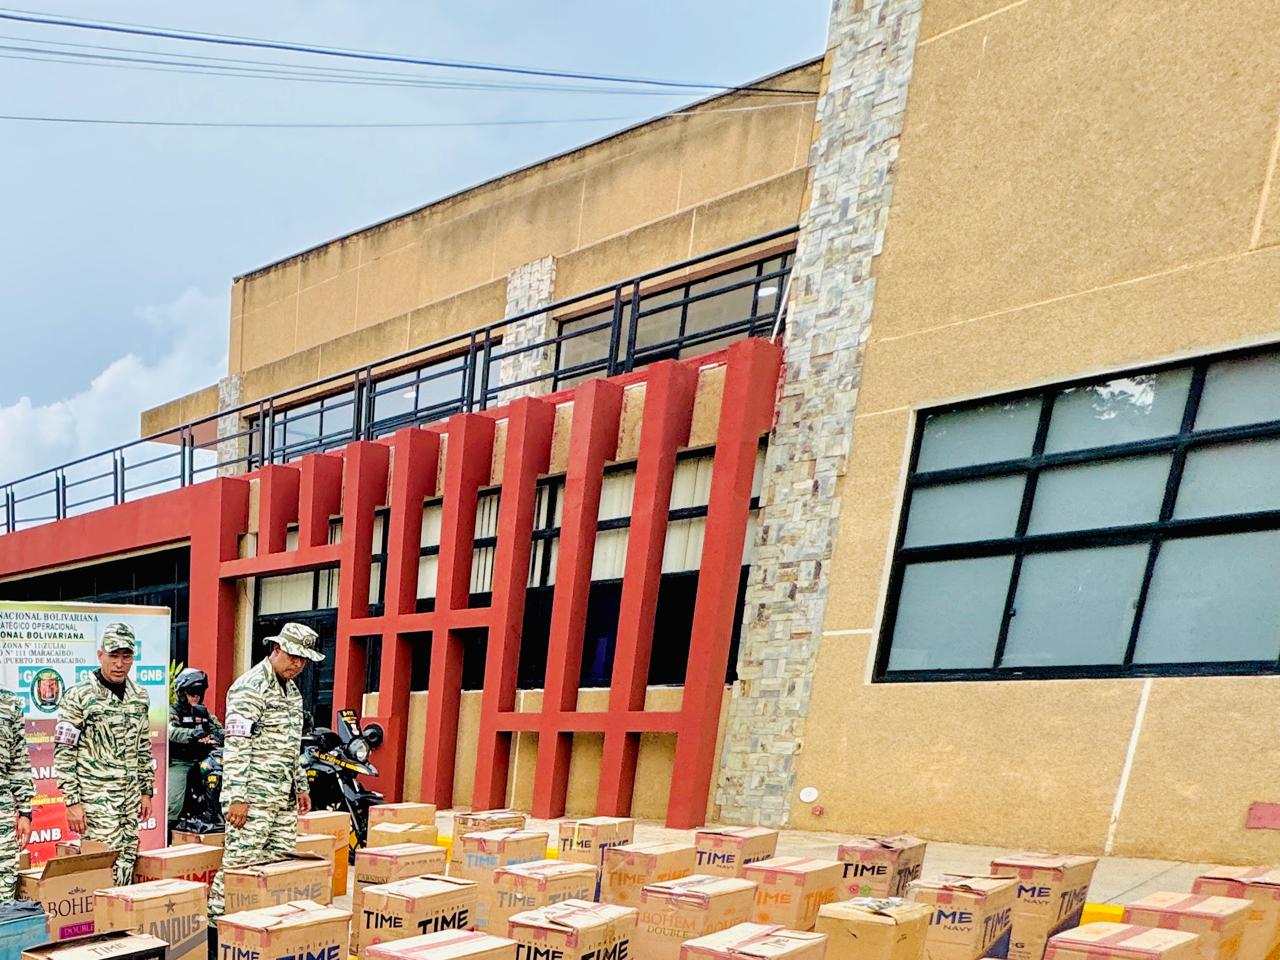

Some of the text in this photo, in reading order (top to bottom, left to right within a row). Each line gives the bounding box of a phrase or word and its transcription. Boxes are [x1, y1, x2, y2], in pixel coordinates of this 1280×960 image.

[44, 612, 98, 622] BOLIVARIANA
[32, 622, 78, 631] OPERACIONAL
[27, 631, 84, 640] BOLIVARIANA
[140, 671, 162, 682] GNB
[29, 828, 62, 844] ANB
[561, 838, 591, 852] TIME
[697, 850, 736, 865] TIME
[842, 863, 887, 878] TIME
[608, 872, 647, 887] TIME
[271, 882, 321, 902] TIME
[497, 890, 536, 908] TIME
[1018, 885, 1051, 898] ME
[48, 896, 94, 919] BOHE
[227, 892, 259, 908] TIME
[1058, 885, 1088, 922] TIME
[363, 909, 403, 929] TIME
[418, 909, 469, 935] TIME
[929, 909, 972, 926] IME
[647, 926, 689, 939] DOUBLE
[983, 908, 1012, 948] TIME
[88, 942, 126, 956] TIME
